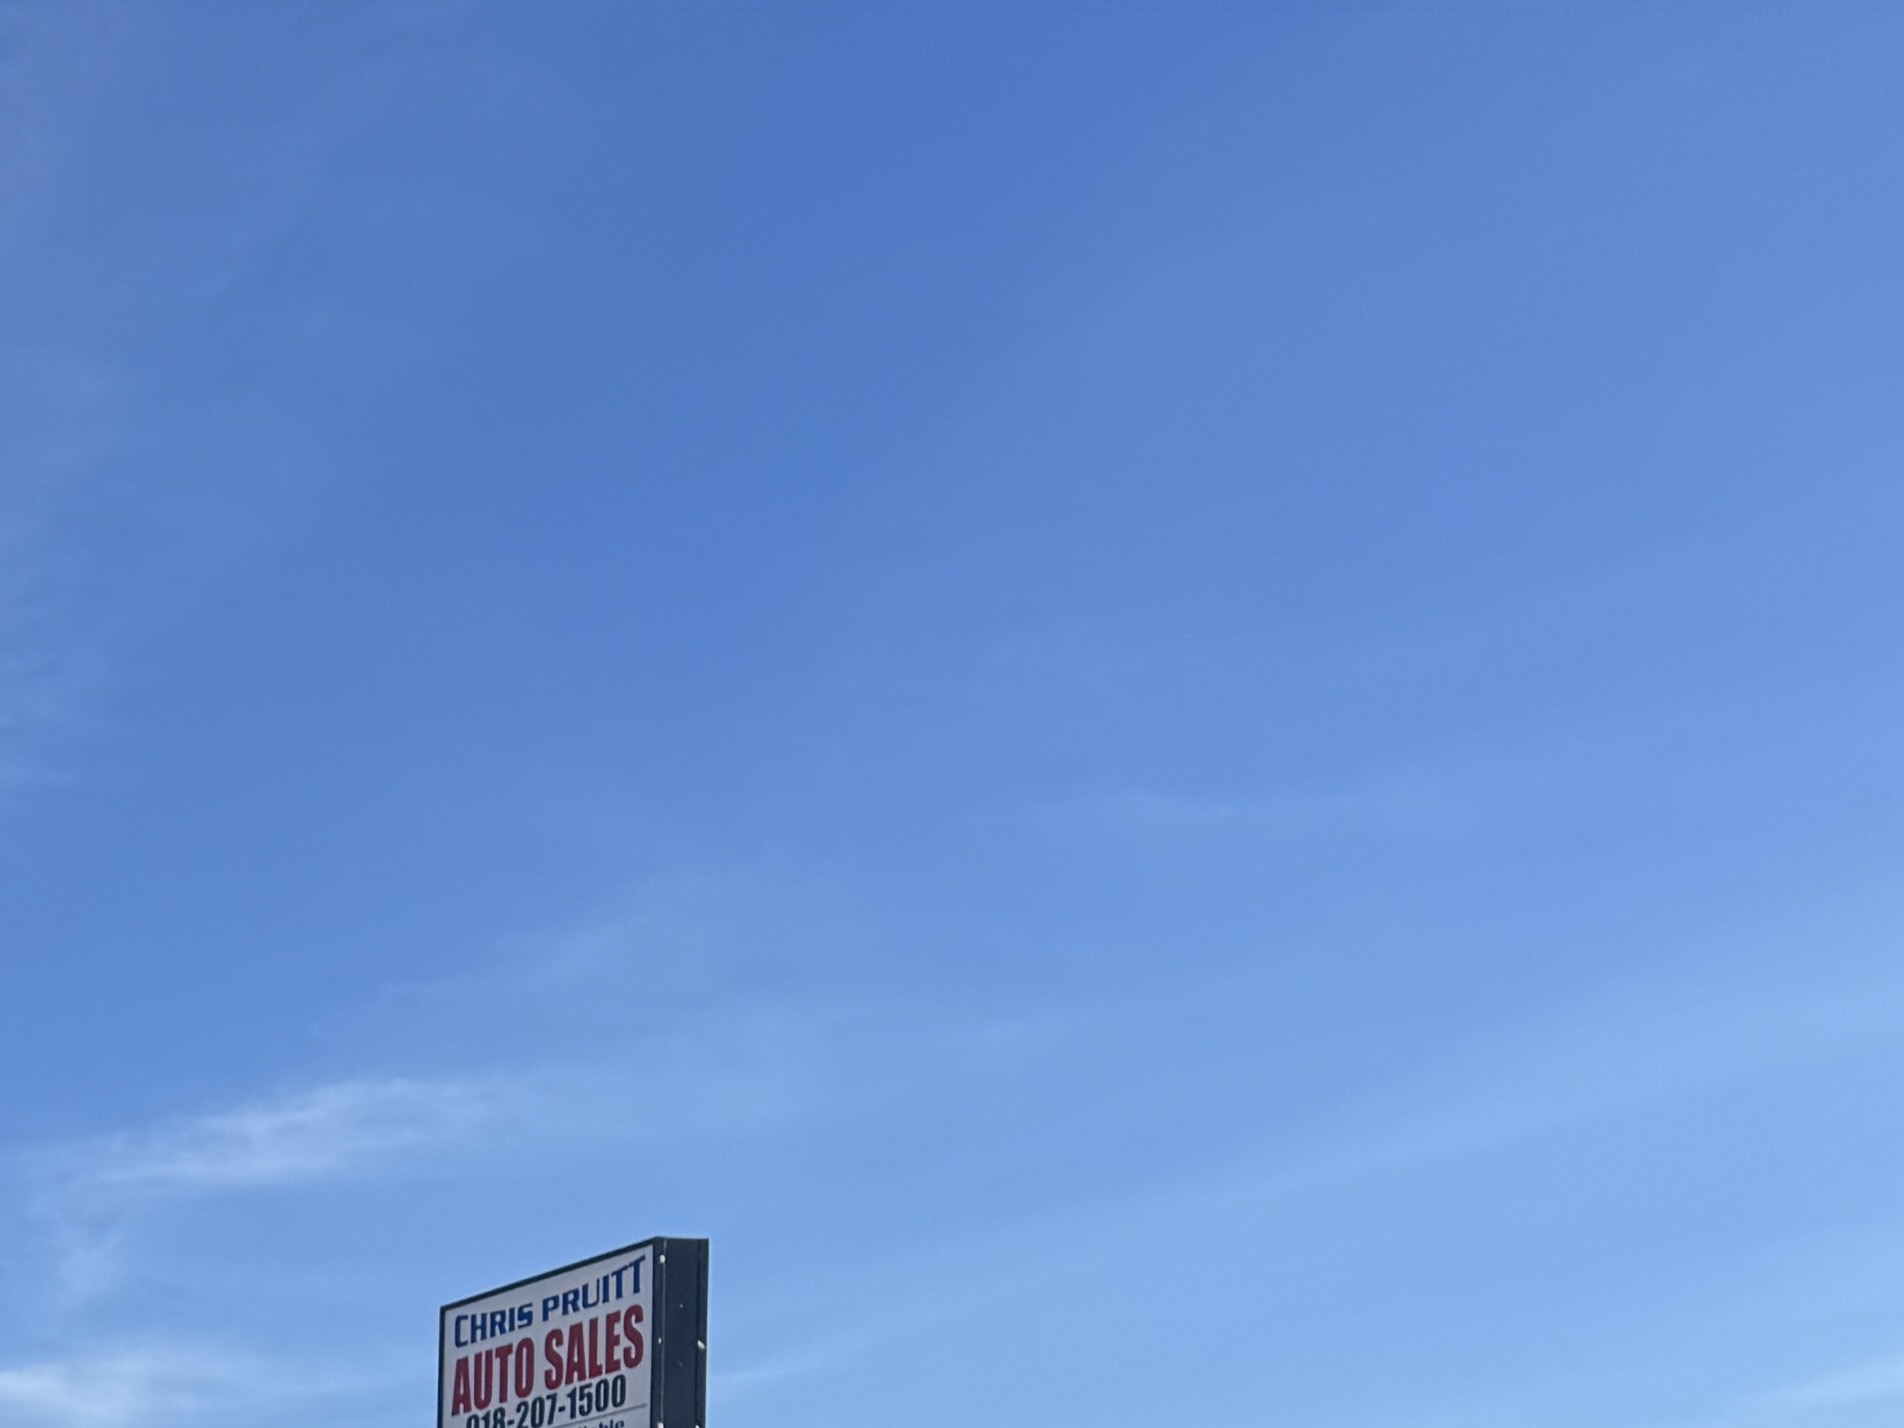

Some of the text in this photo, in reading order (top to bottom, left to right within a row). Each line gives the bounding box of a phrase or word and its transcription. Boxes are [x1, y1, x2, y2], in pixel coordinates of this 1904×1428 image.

[454, 1255, 646, 1348] CHRIS PRUITT
[451, 1304, 644, 1417] AUTO SALES
